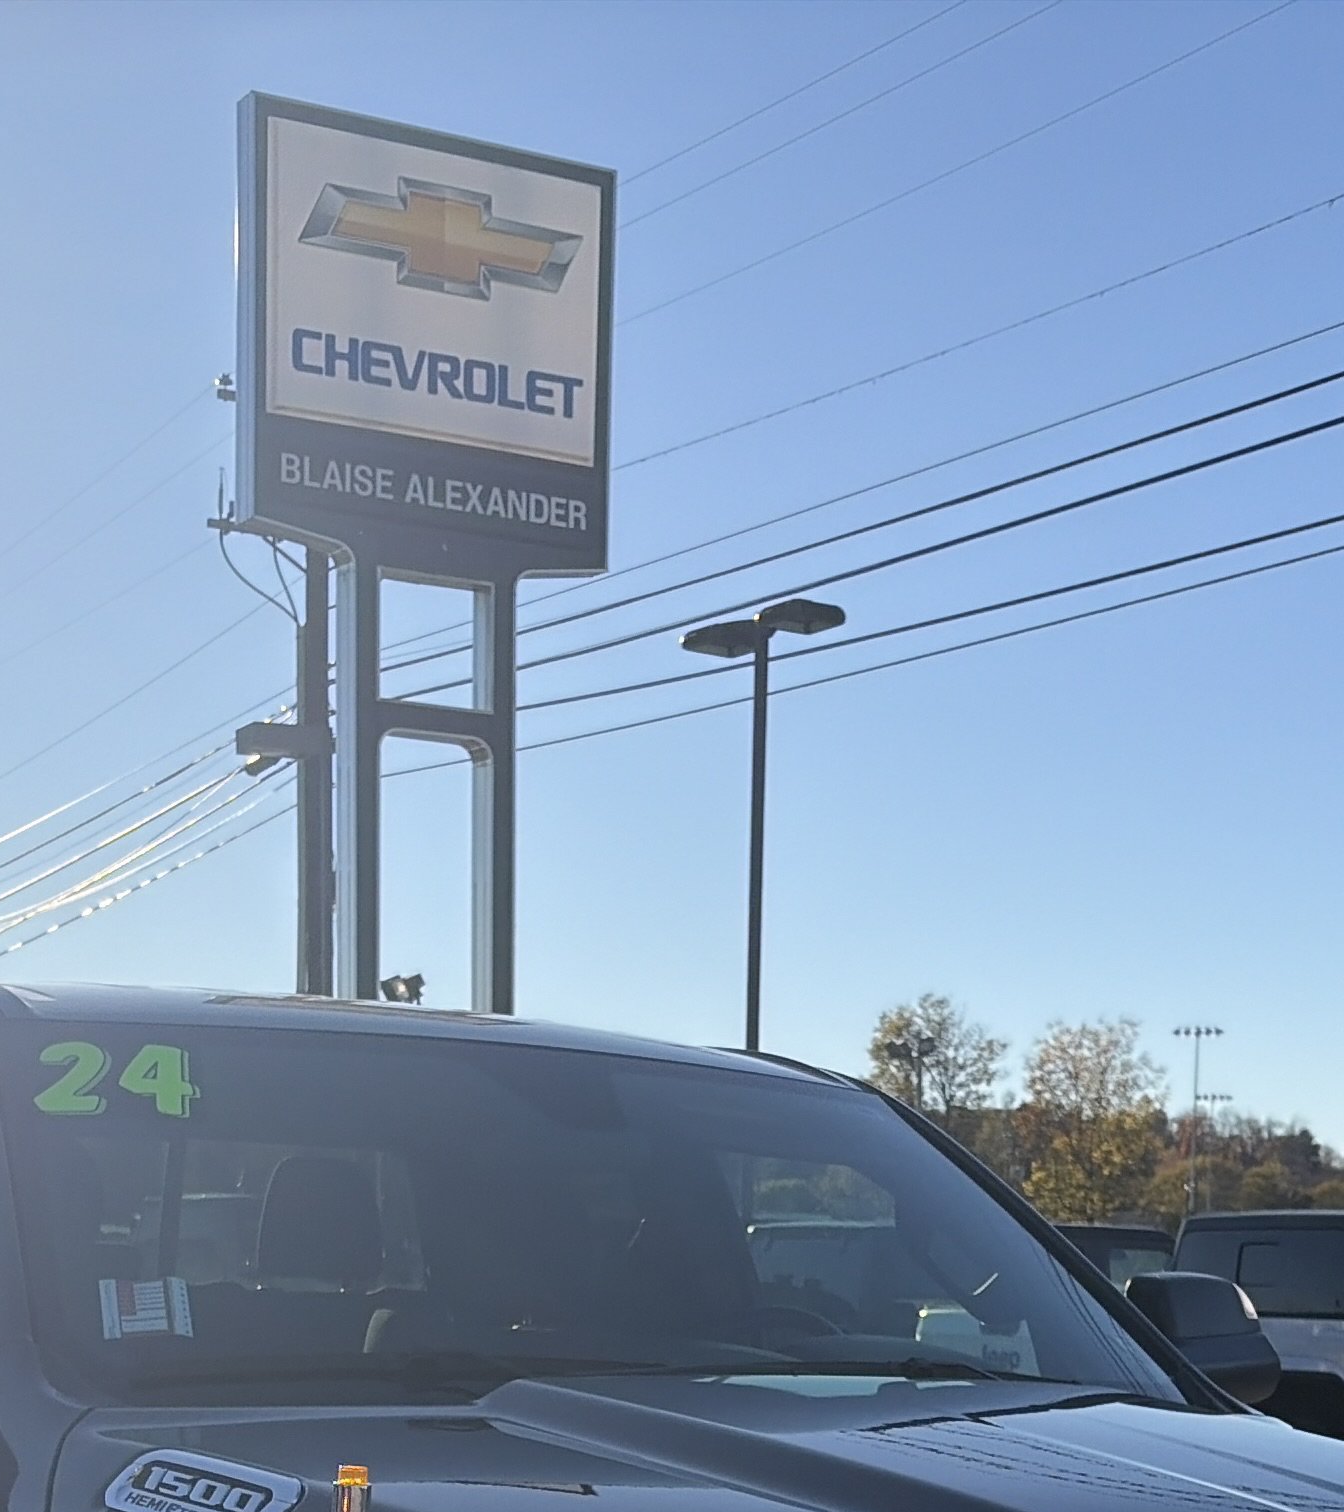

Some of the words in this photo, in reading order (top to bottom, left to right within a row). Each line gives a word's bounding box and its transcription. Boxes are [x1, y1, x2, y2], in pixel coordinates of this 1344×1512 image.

[291, 327, 584, 419] CHEVROLET
[280, 452, 394, 501] BLAISE
[405, 473, 587, 531] ALEXANDER
[33, 1041, 201, 1118] 24
[124, 1491, 166, 1512] HEMI
